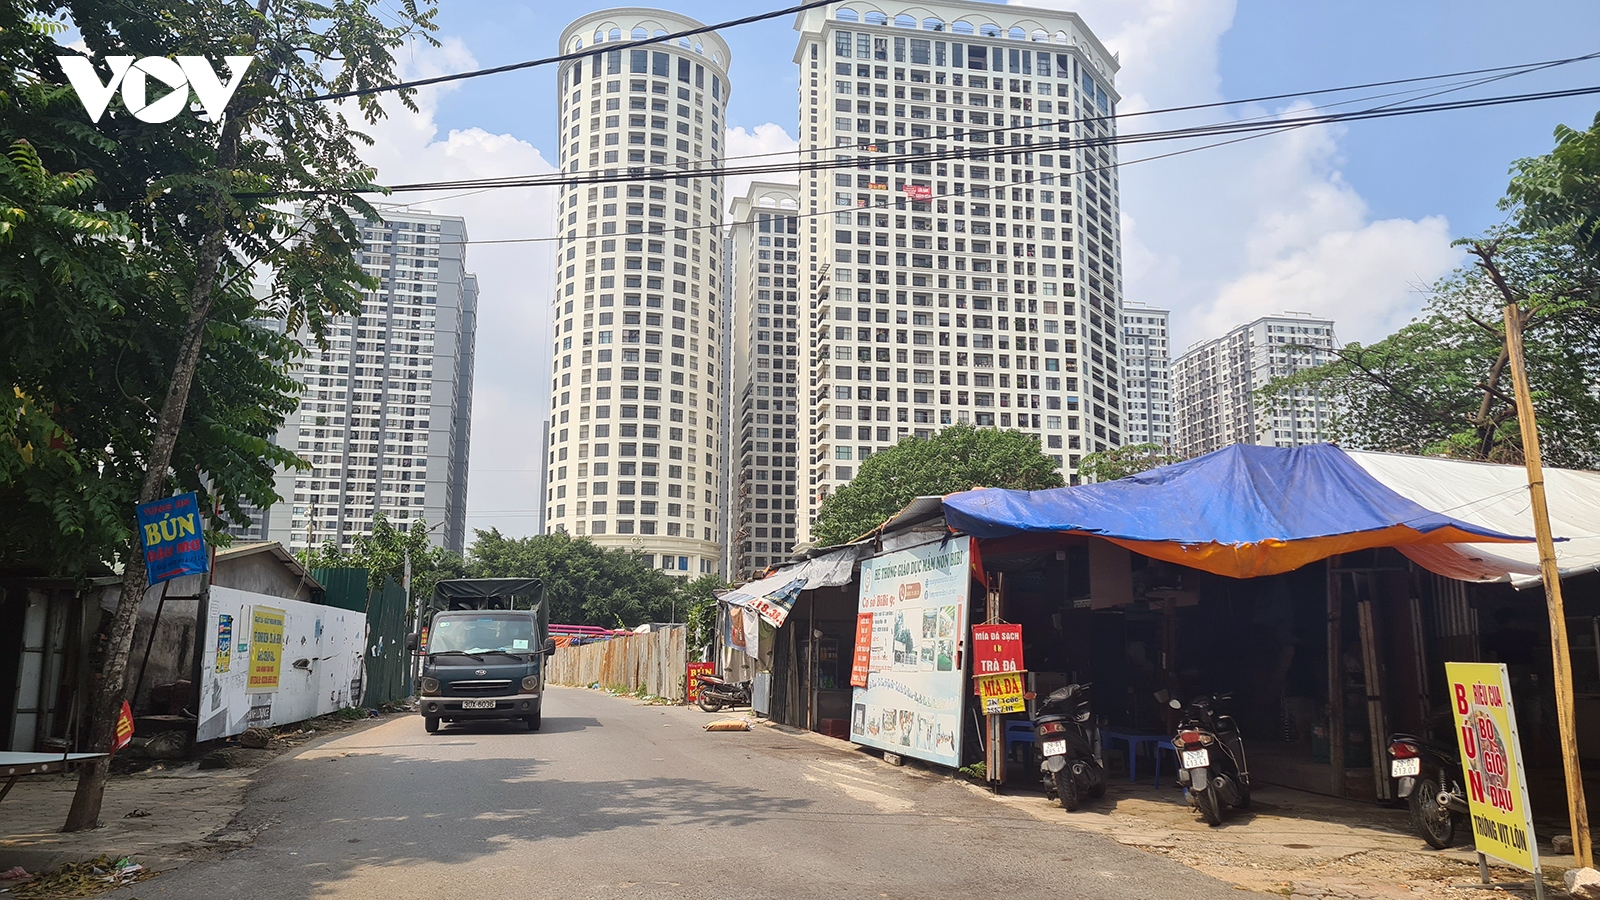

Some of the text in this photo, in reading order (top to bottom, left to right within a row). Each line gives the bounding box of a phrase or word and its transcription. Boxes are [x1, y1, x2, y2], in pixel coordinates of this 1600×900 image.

[144, 513, 195, 547] BÚN
[936, 553, 950, 570] NON
[975, 631, 1020, 642] MÍA ĐÁ SẠCH
[981, 658, 1017, 672] TRÀ ĐÁ
[983, 675, 1004, 697] MÍA
[1004, 673, 1020, 695] ĐÁ
[1488, 685, 1503, 708] CUA
[1478, 714, 1495, 740] BÒ
[1490, 783, 1513, 814] ĐẬU
[1497, 822, 1510, 849] VỊT
[1510, 824, 1527, 854] LỘN
